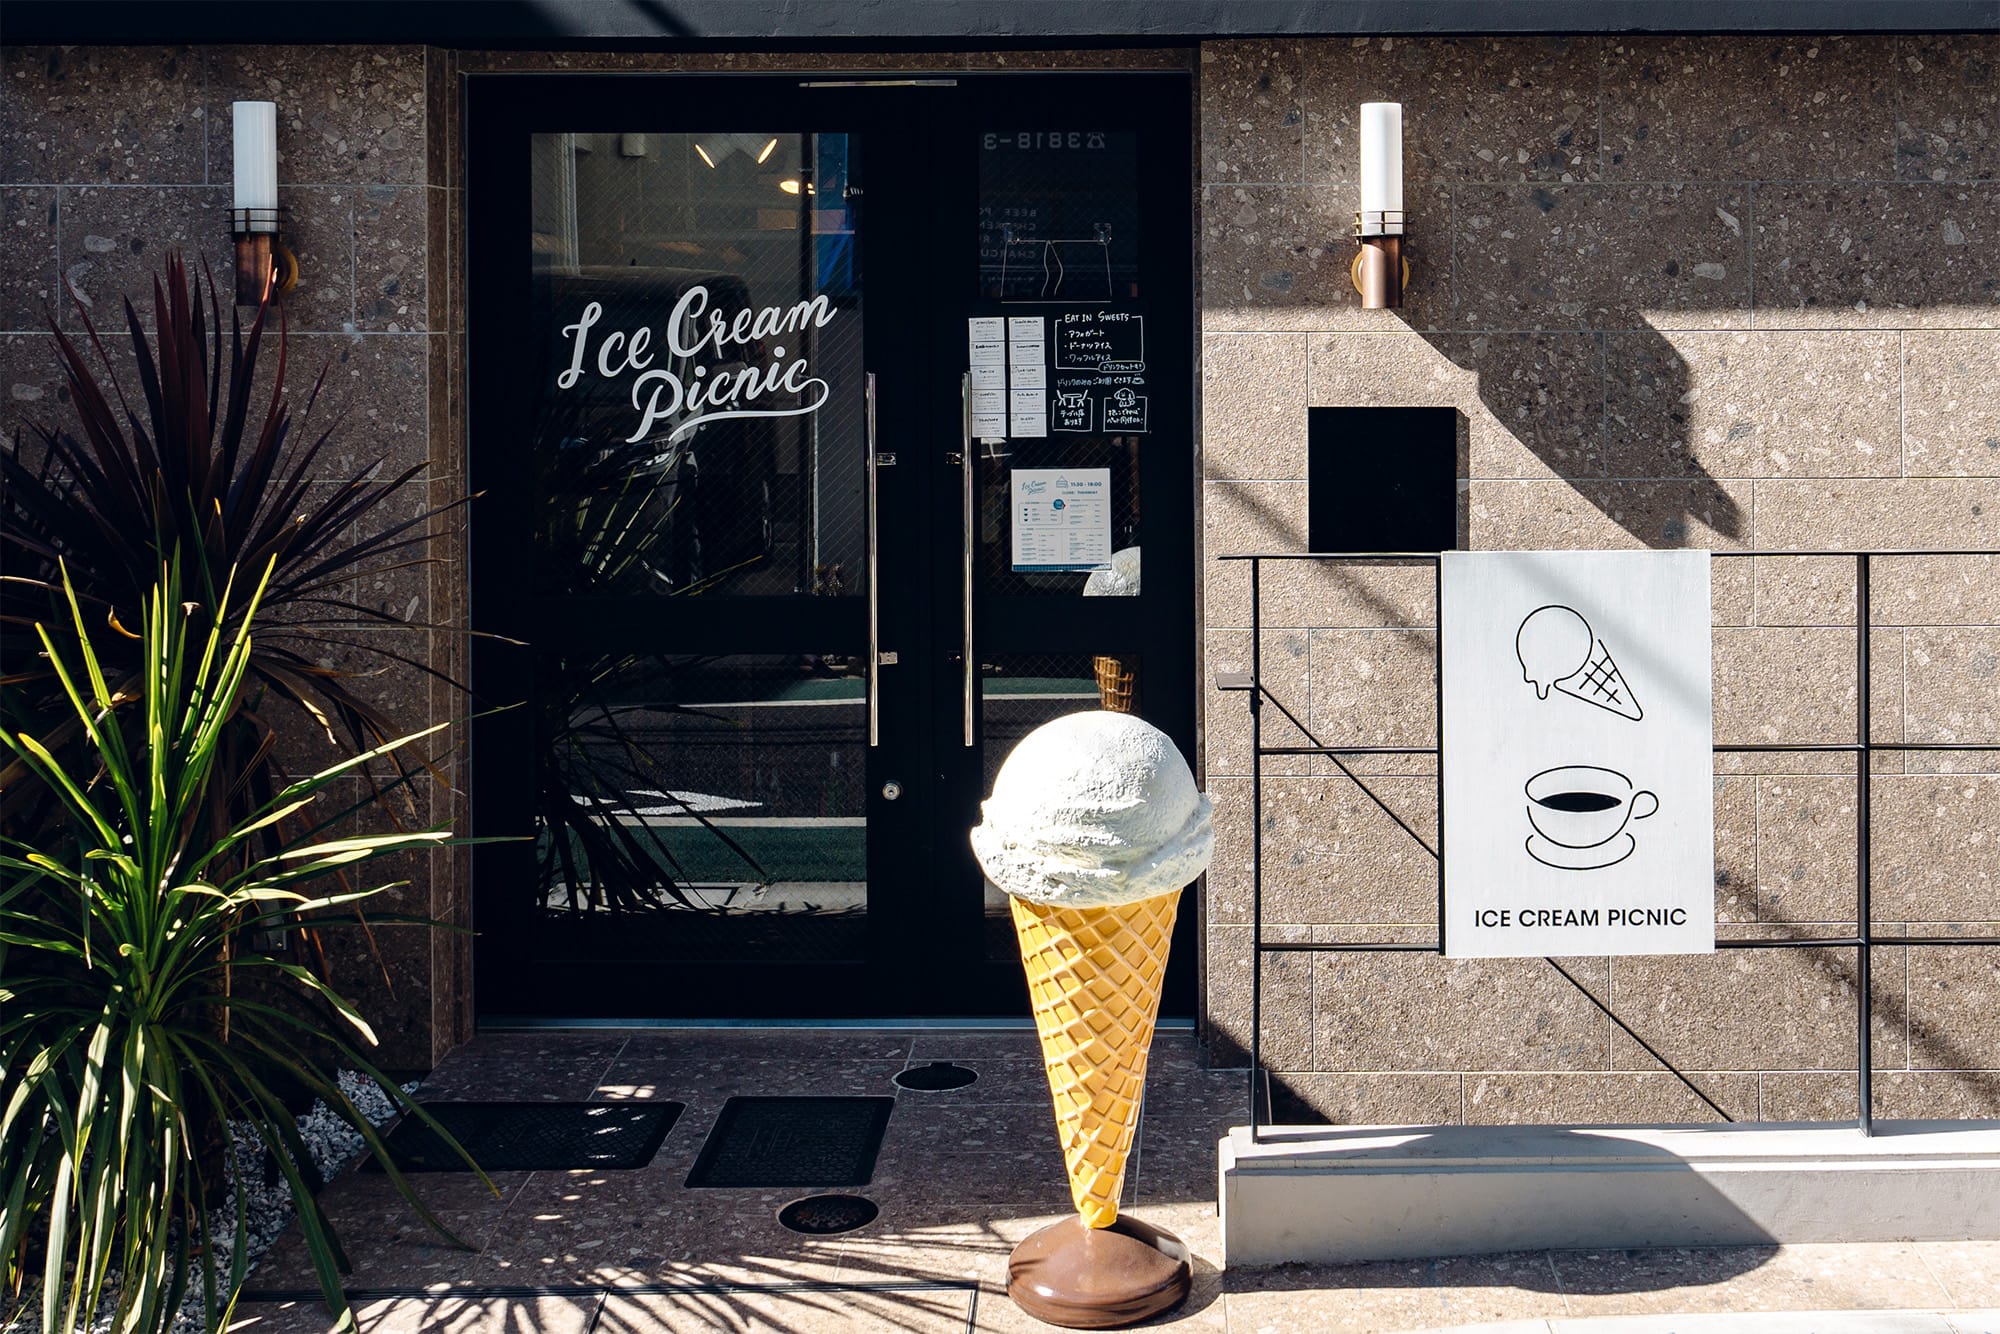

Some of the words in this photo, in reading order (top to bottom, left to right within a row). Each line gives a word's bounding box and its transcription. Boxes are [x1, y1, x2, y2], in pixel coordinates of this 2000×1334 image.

[557, 301, 655, 389] Ice
[667, 285, 838, 360] Cream
[1064, 313, 1080, 323] EAT
[1081, 313, 1092, 322] IN
[1097, 310, 1130, 322] SWEETS
[625, 345, 830, 443] Picnic
[1474, 909, 1511, 927] ICE
[1518, 909, 1600, 927] CREAM
[1607, 908, 1687, 926] PICNIC
